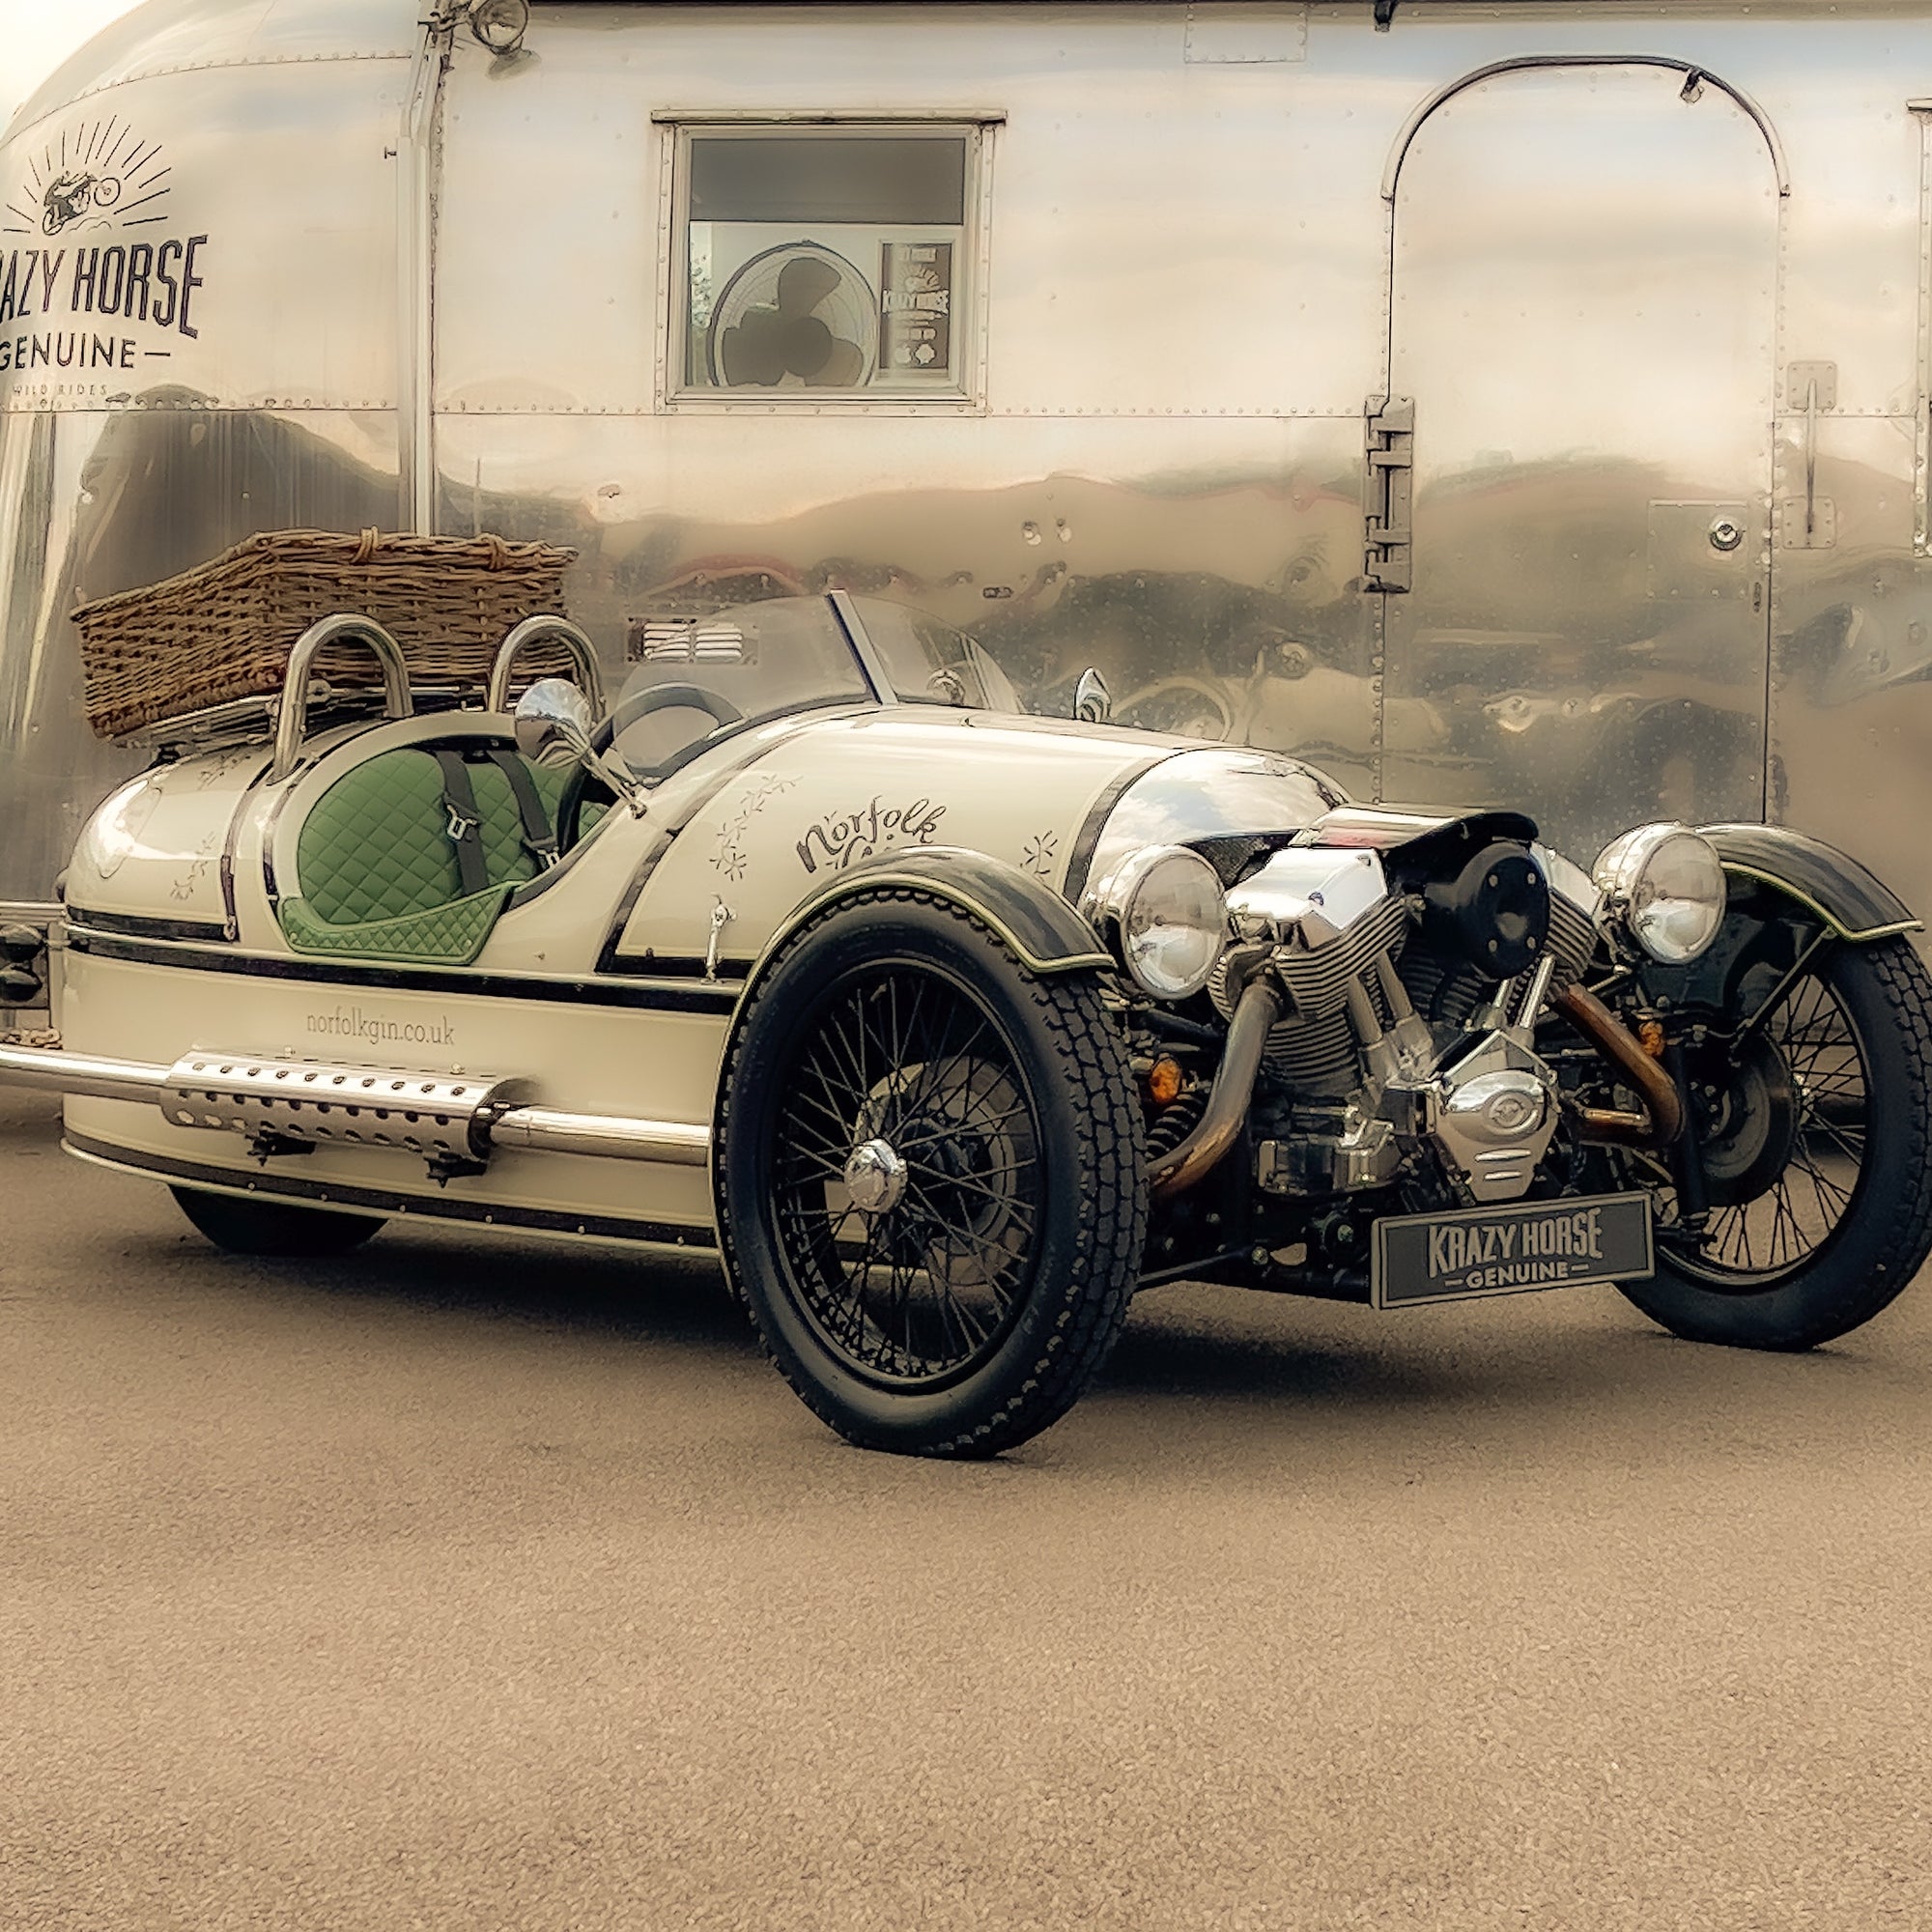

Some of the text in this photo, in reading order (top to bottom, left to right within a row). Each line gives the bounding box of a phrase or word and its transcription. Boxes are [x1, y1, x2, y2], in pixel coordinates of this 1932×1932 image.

[0, 235, 209, 339] AZY HORSE
[0, 332, 136, 371] GENUINE
[306, 1005, 455, 1045] norfolkgin.co.uk
[1428, 1207, 1604, 1279] KRAZY HORSE
[1464, 1261, 1569, 1289] GENUINE
